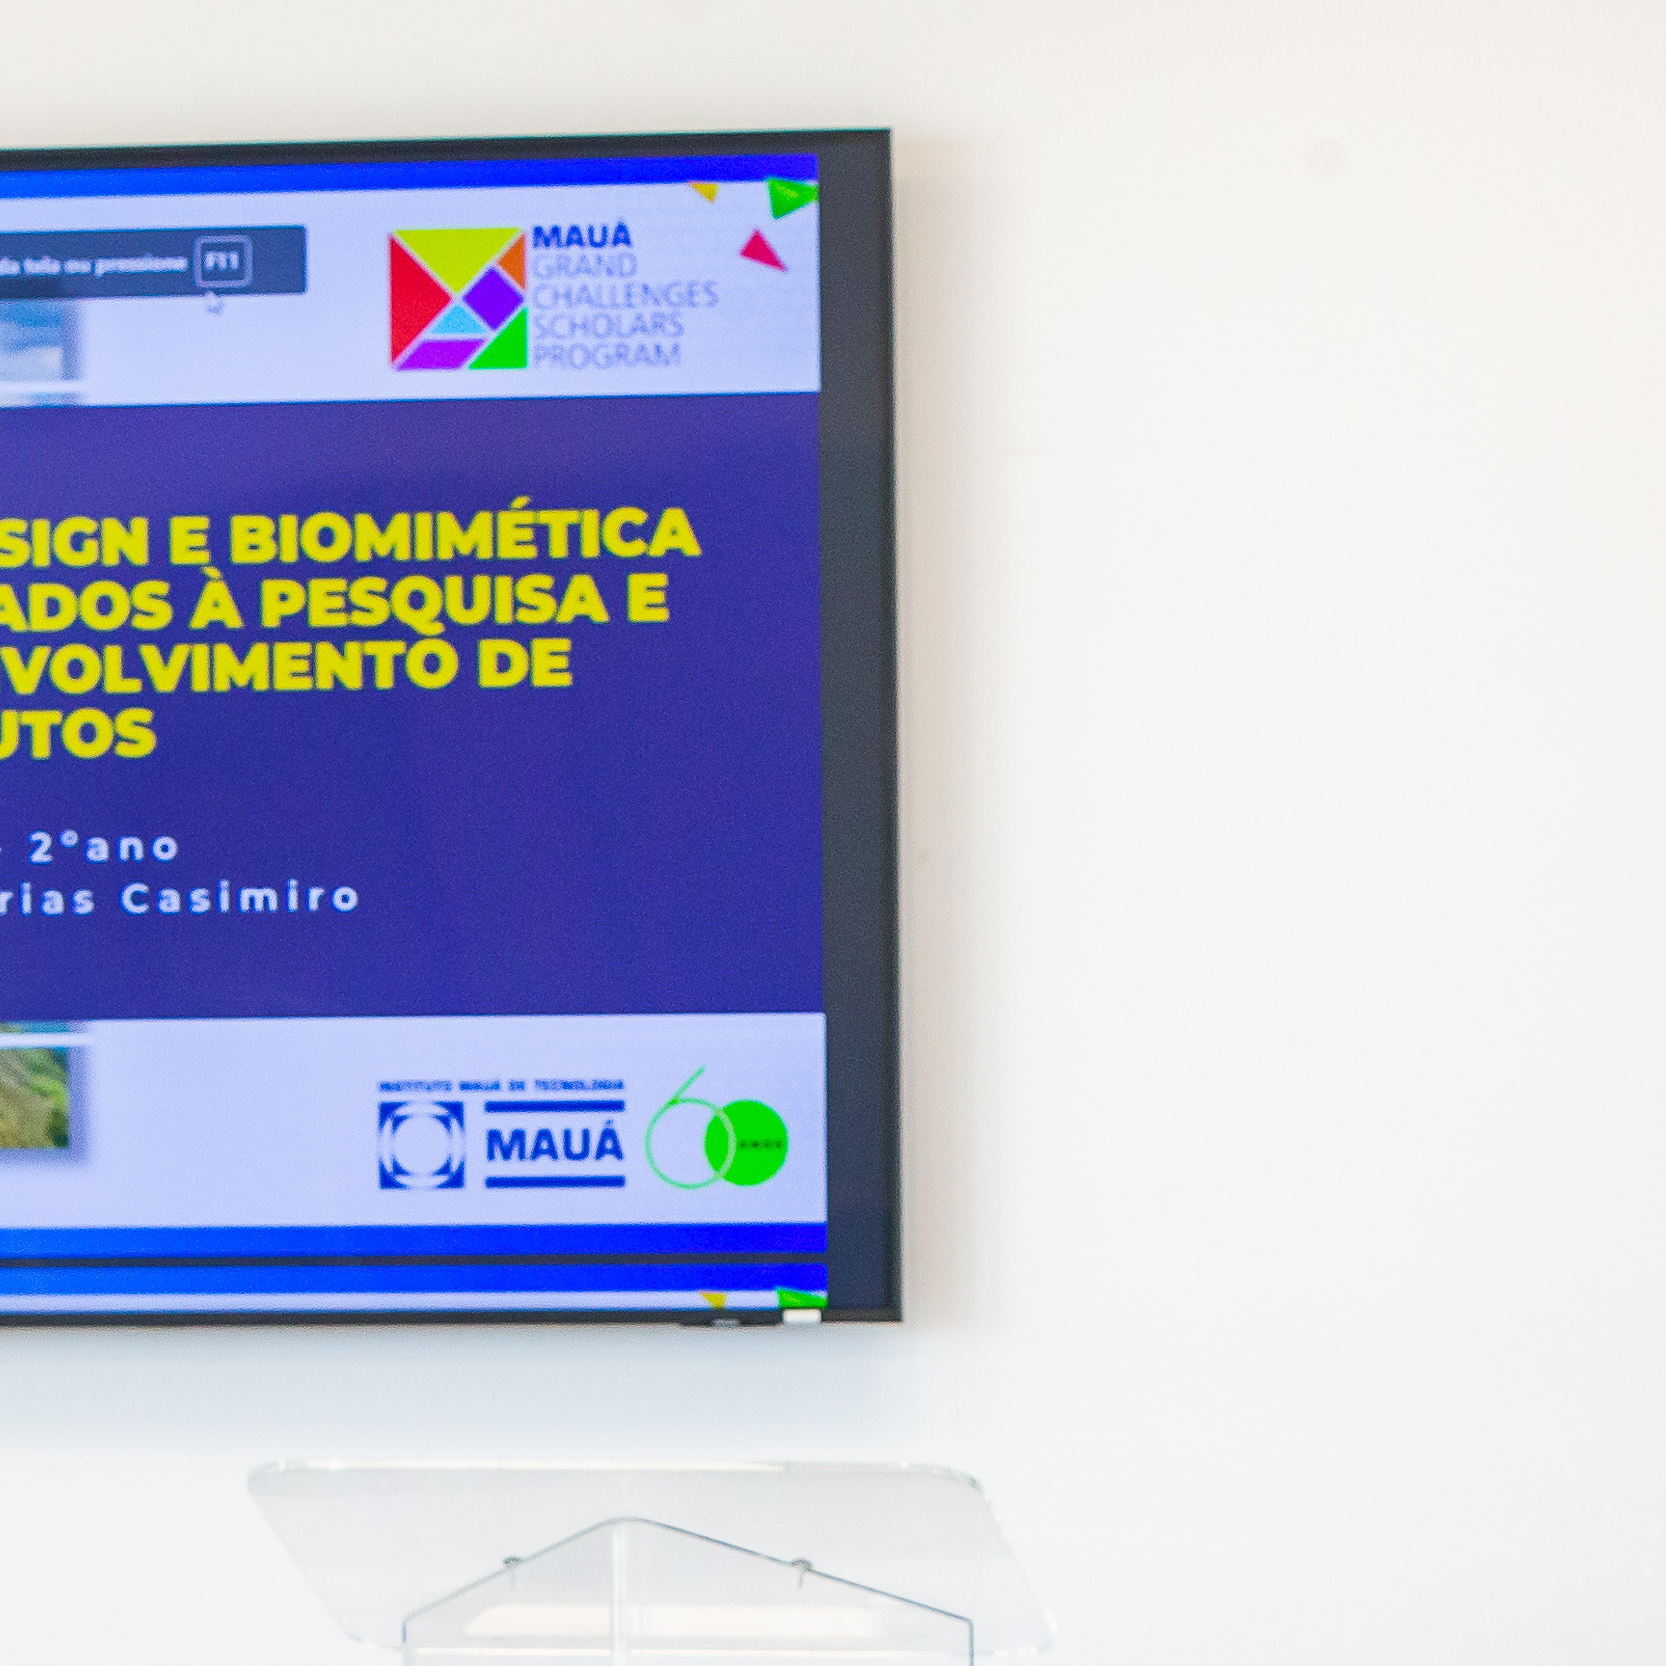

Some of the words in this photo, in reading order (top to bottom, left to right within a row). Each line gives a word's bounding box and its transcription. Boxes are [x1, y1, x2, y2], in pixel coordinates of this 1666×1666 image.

[533, 217, 631, 248] MAUÁ
[22, 256, 61, 275] tela
[533, 253, 637, 279] GRAND
[533, 280, 719, 309] CHALLENGES
[533, 311, 684, 341] SCHOLARS
[534, 342, 681, 369] PROGRAM
[170, 516, 213, 568] E
[231, 496, 701, 563] BIOMIMÉTICA
[190, 566, 243, 629] À
[262, 574, 609, 635] PESQUISA
[628, 573, 669, 622] E
[479, 638, 572, 687] DE
[121, 879, 358, 914] Casimiro
[487, 1120, 623, 1161] MAUÁ
